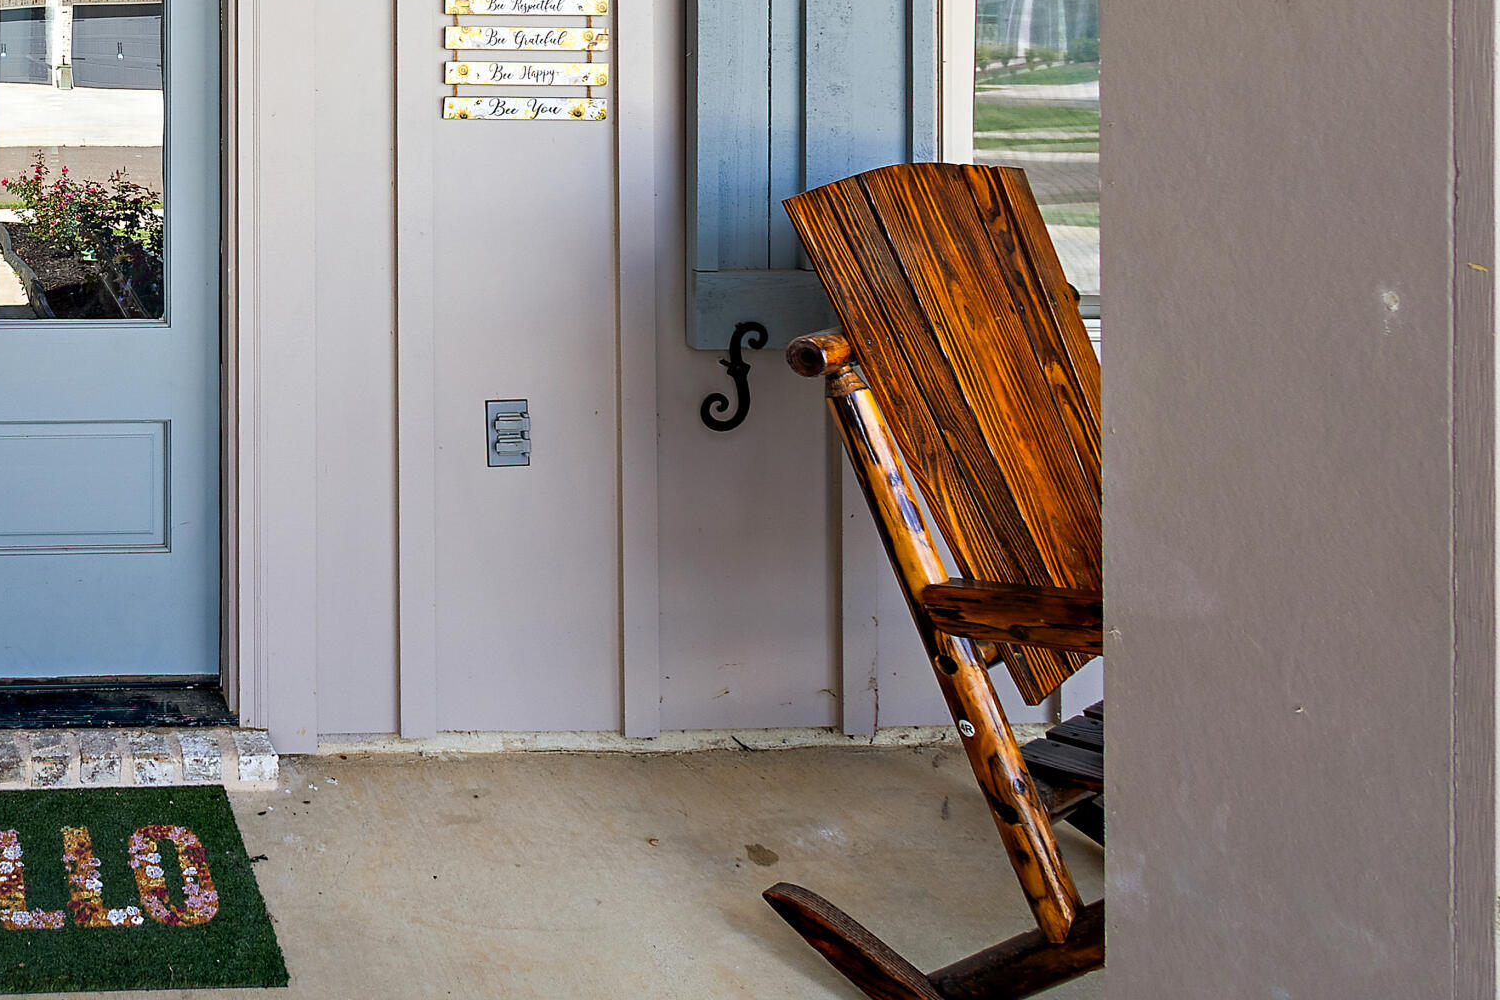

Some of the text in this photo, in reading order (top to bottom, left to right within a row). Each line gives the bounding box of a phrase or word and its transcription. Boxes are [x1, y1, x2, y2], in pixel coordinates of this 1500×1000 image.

[485, 27, 568, 47] Bee Grateful
[488, 62, 556, 85] Bee Happy
[488, 97, 562, 119] Bee You
